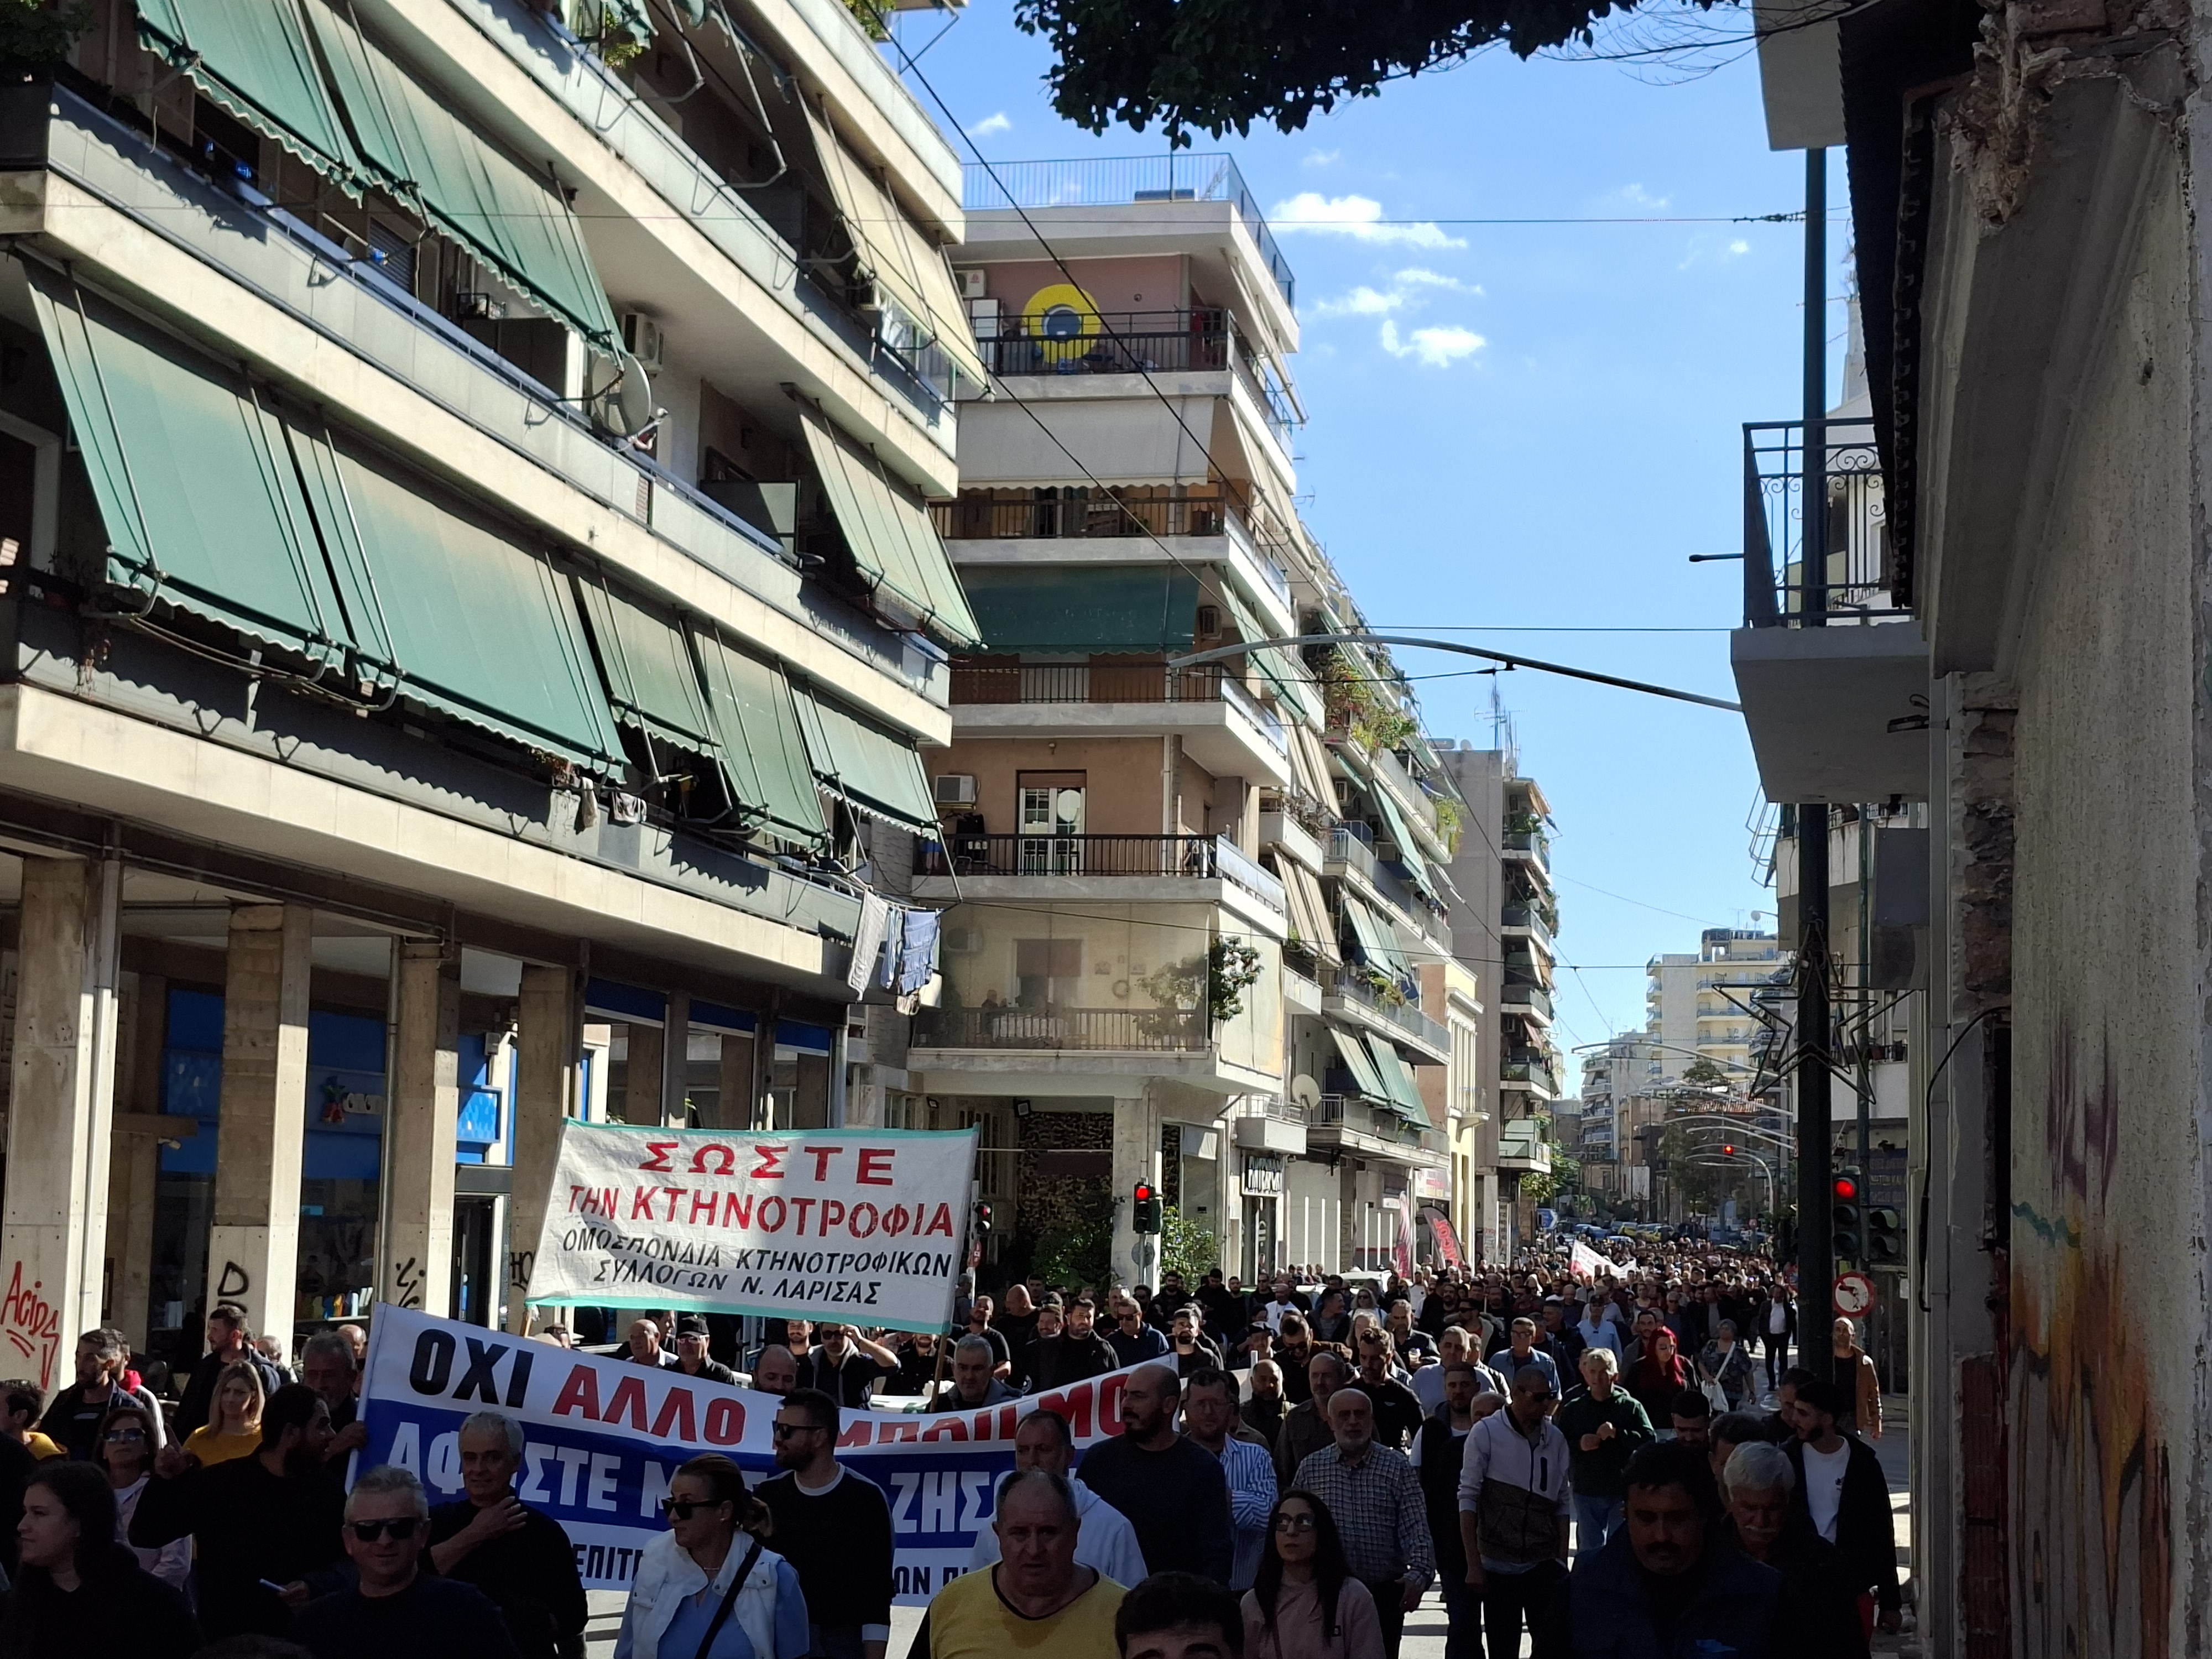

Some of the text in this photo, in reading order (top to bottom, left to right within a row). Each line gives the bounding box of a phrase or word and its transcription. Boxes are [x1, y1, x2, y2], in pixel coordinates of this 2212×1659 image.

[638, 1141, 896, 1186] ΣΩΣΤΕ
[568, 1185, 953, 1239] ΤΗΝ ΚΤΗΝΟΤΡΟΦΙΑ
[562, 1227, 952, 1277] ΟΜΟΣΠΟΝΔΙΑ ΚΤΗΝΟΤΡΟΦΙΚΩΝ
[593, 1259, 882, 1305] ΣΥΛΛΟΓΩΝ Ν. ΛΑΡΙΣΑΣ
[409, 1329, 534, 1408] ΟΧΙ
[552, 1364, 746, 1446] ΑΛΛΟ
[387, 1421, 622, 1514] ΑΦΣΤΕ
